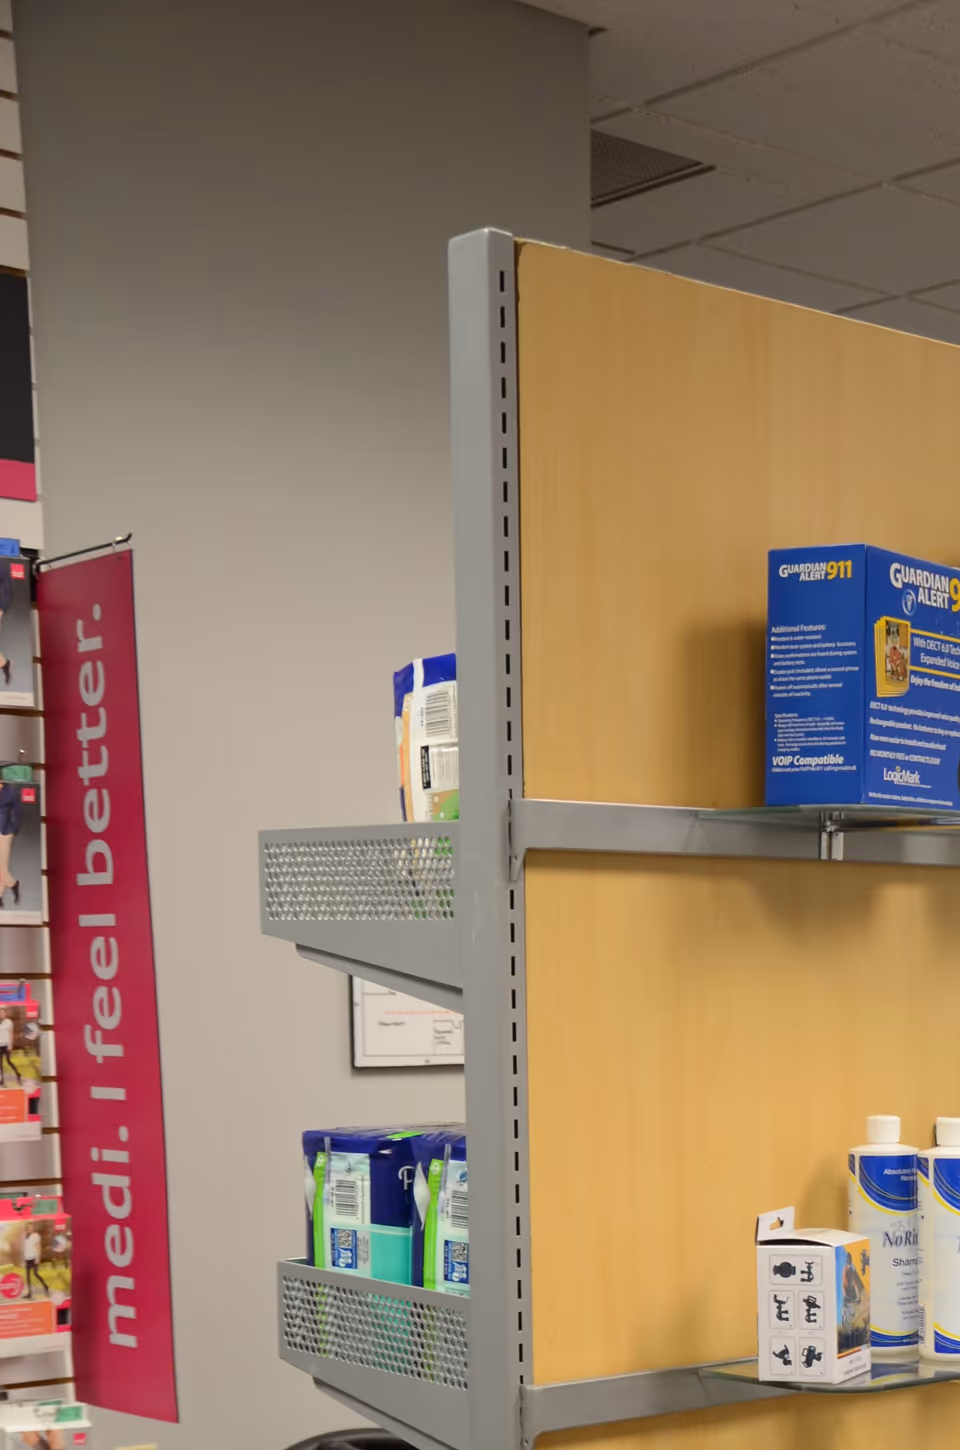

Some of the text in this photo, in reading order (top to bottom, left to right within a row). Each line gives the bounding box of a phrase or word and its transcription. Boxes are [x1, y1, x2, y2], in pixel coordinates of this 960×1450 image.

[779, 562, 827, 578] GUARDIAN
[799, 560, 852, 581] ALERT 911
[889, 562, 949, 593] GUARDIAN
[917, 587, 949, 609] ALERT
[772, 753, 844, 767] VOIP Compatible
[883, 767, 920, 784] LogicMark
[76, 603, 138, 1348] medi. I feel better.
